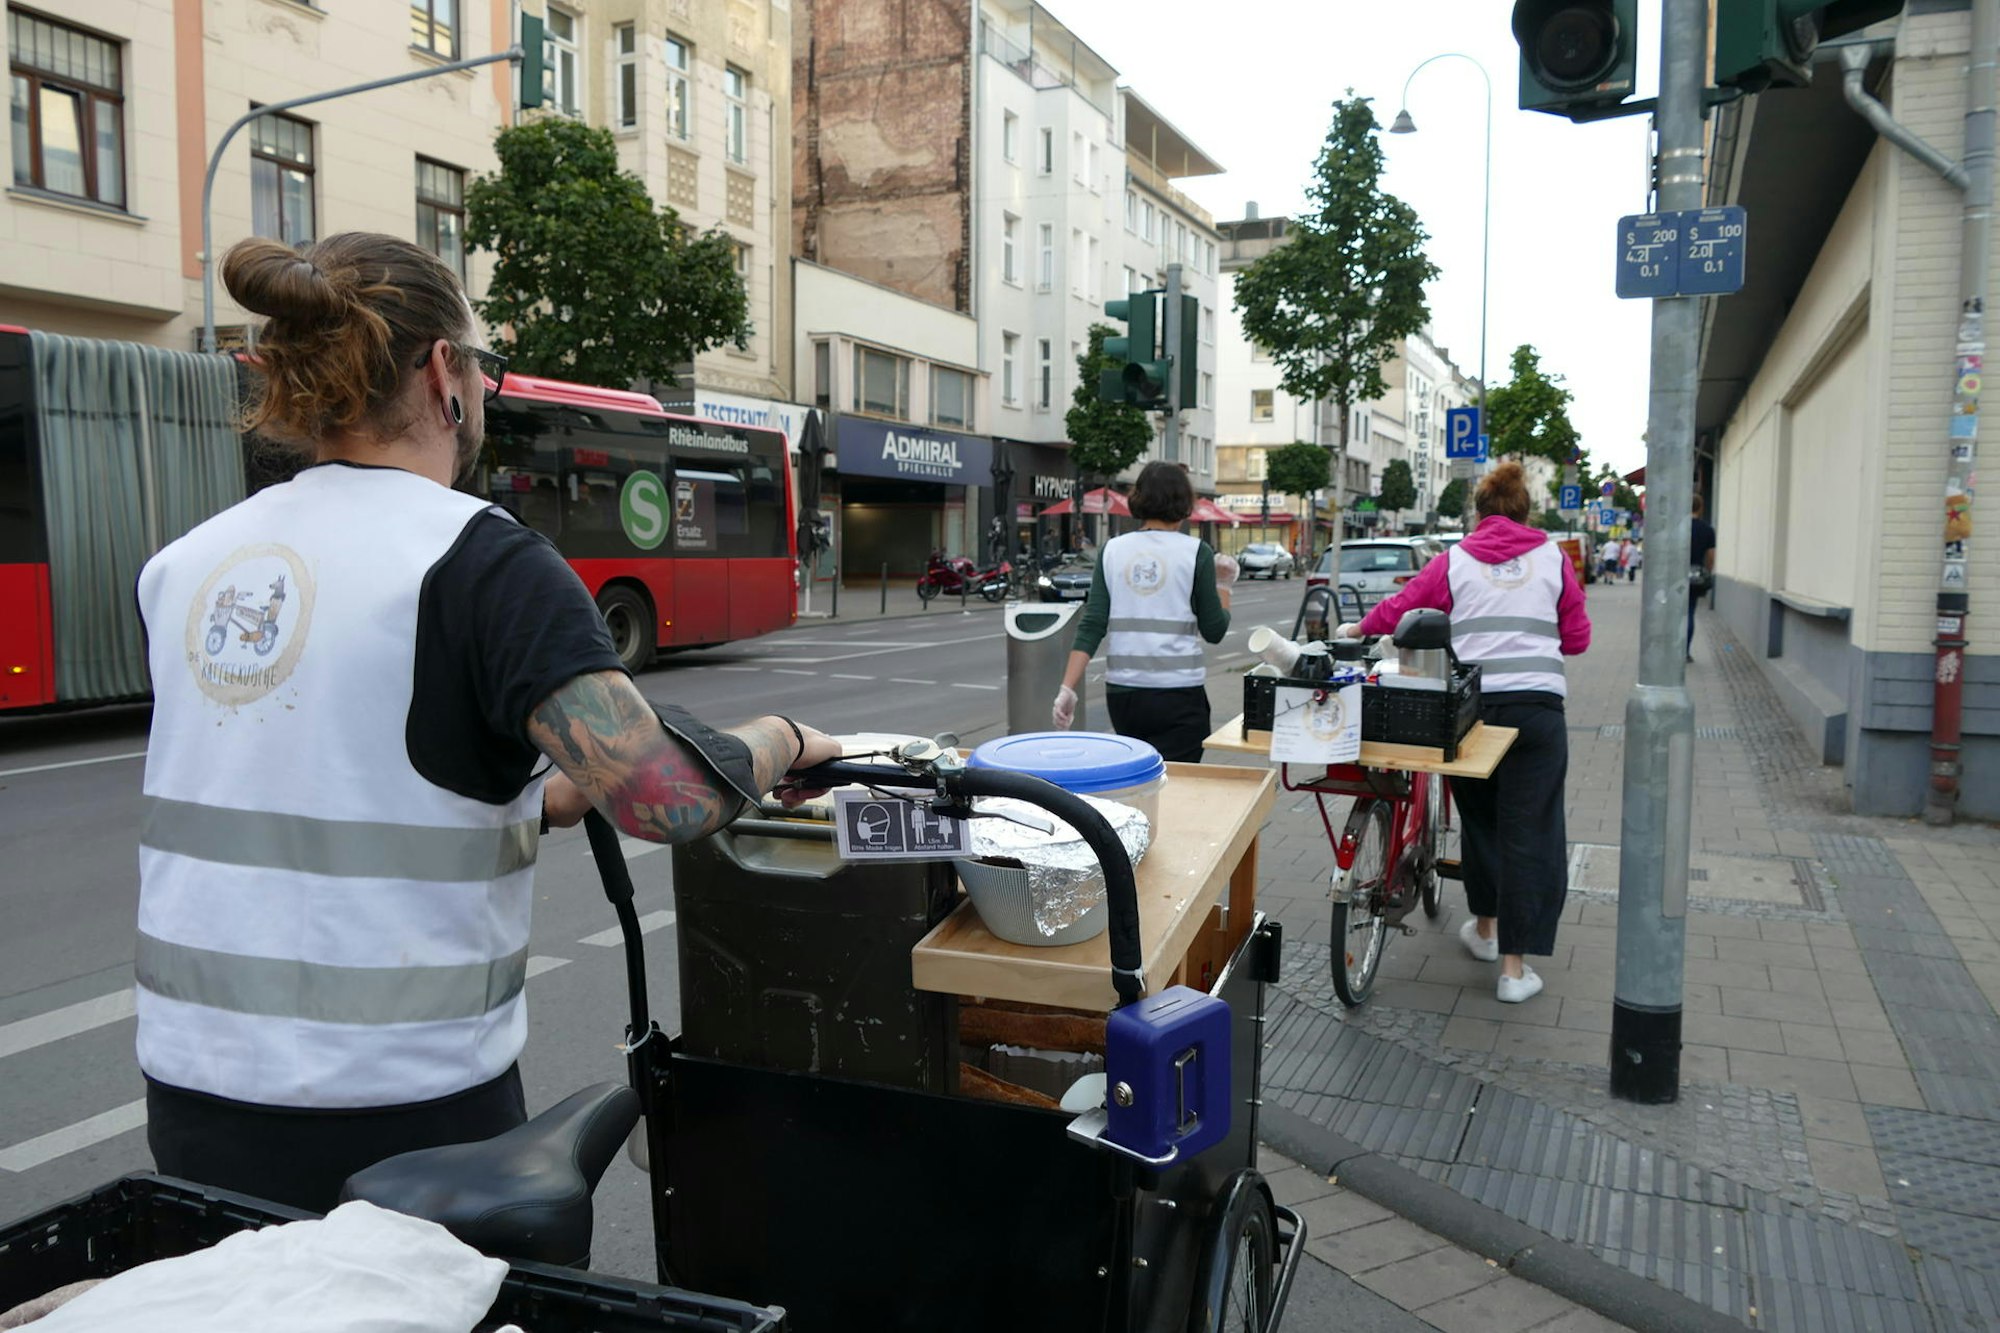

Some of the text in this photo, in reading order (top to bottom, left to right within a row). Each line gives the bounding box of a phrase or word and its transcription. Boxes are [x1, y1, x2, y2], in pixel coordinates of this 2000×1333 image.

[1626, 229, 1677, 245] S 200
[1689, 224, 1742, 240] S 100
[1640, 264, 1659, 277] 0.1
[1704, 260, 1723, 273] 0.1
[669, 426, 749, 454] Rheinlandbus
[1453, 413, 1473, 453] P
[882, 431, 962, 468] ADMIRAL
[898, 462, 954, 478] SPIELHALLE
[1564, 488, 1576, 507] P
[629, 480, 662, 541] S
